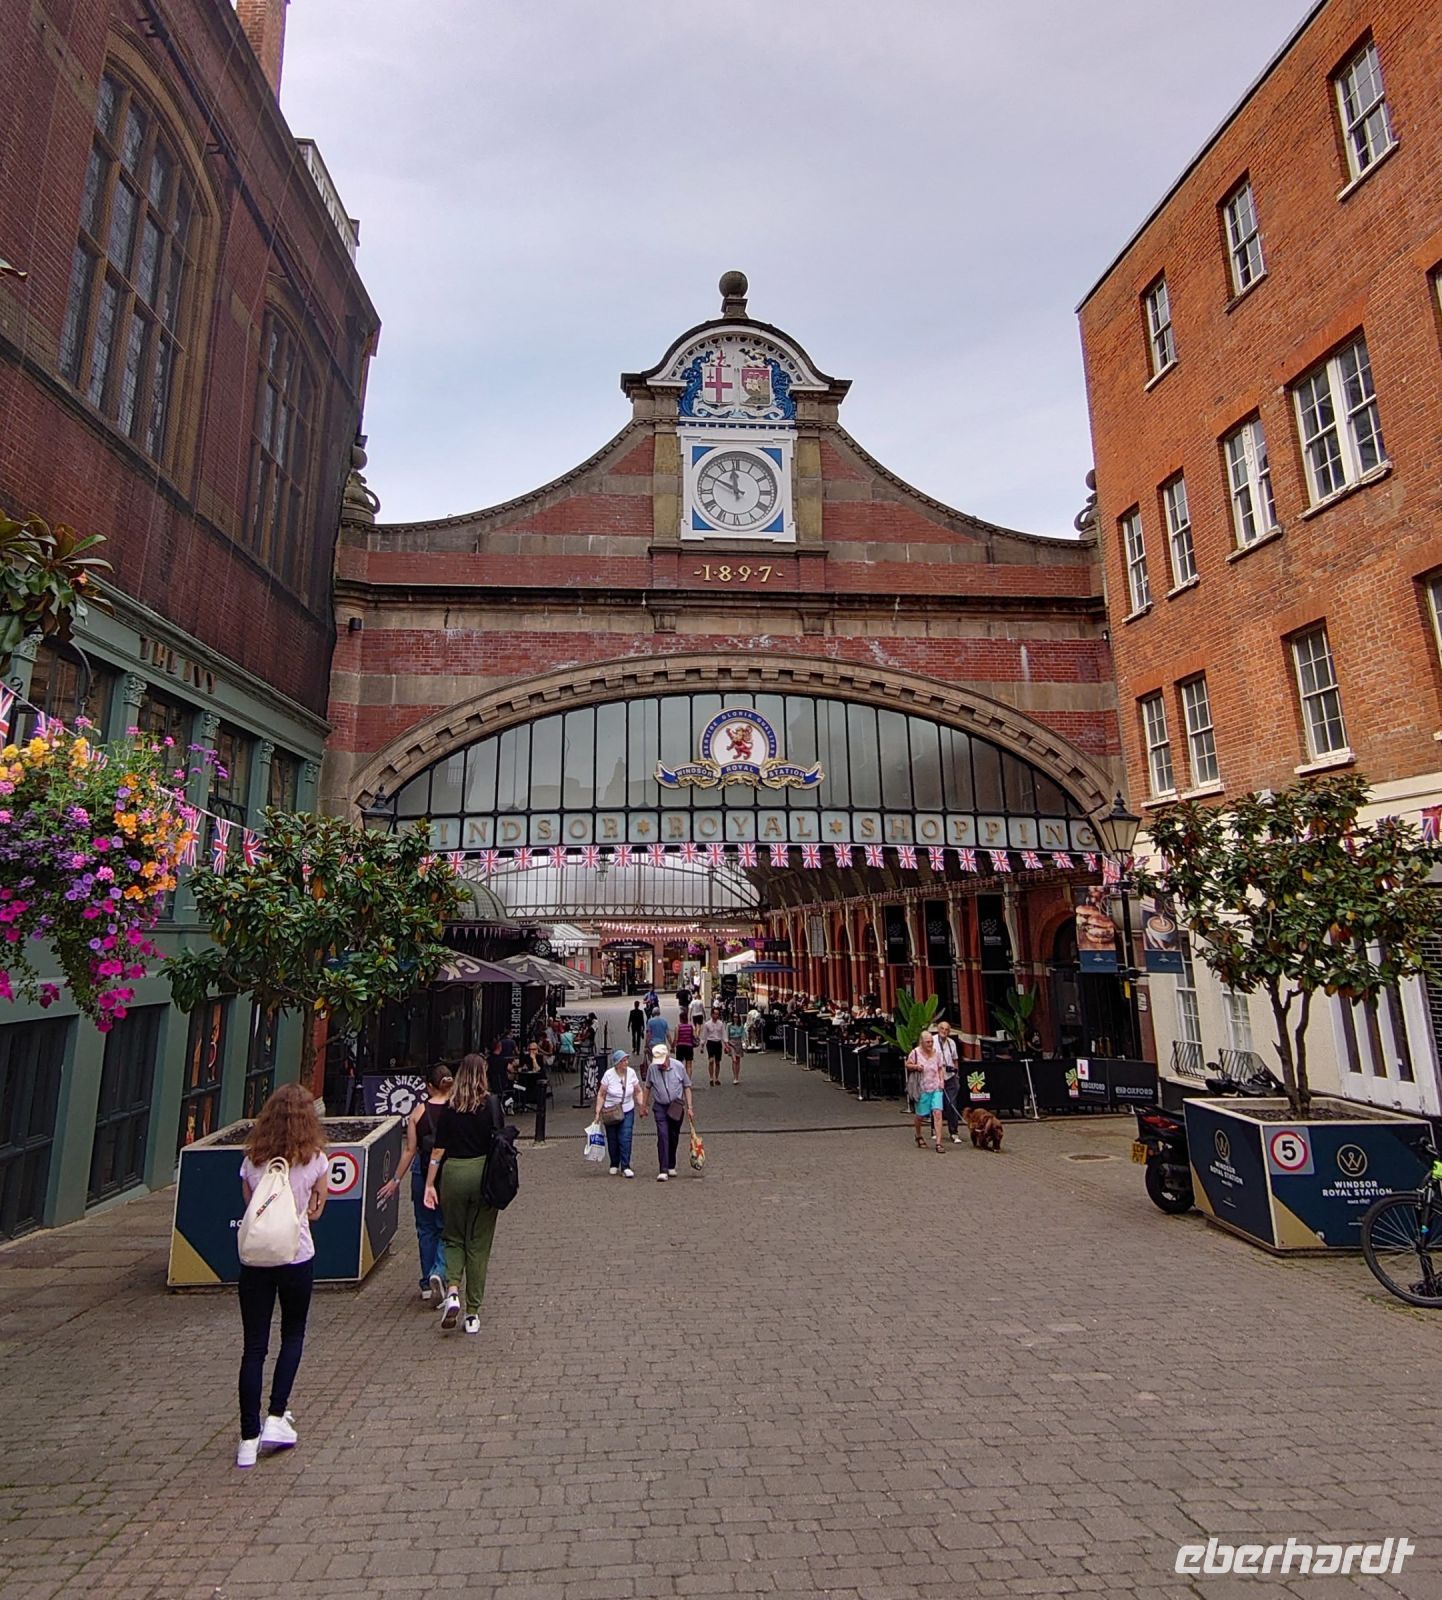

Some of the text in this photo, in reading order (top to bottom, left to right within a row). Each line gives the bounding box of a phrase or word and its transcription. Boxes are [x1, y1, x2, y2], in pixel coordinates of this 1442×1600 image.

[140, 636, 217, 694] THE IVY
[676, 764, 806, 778] WINDSOR ROYAL STATION
[440, 814, 1096, 845] INDSOR ROYAL SHOPPING
[374, 1075, 427, 1115] BLACK SHEEP
[1126, 1087, 1154, 1095] OXFORD
[1281, 1140, 1297, 1162] 5
[331, 1161, 347, 1185] 5
[1322, 1187, 1393, 1197] ROYAL STATION
[1334, 1180, 1379, 1189] WINDSOR
